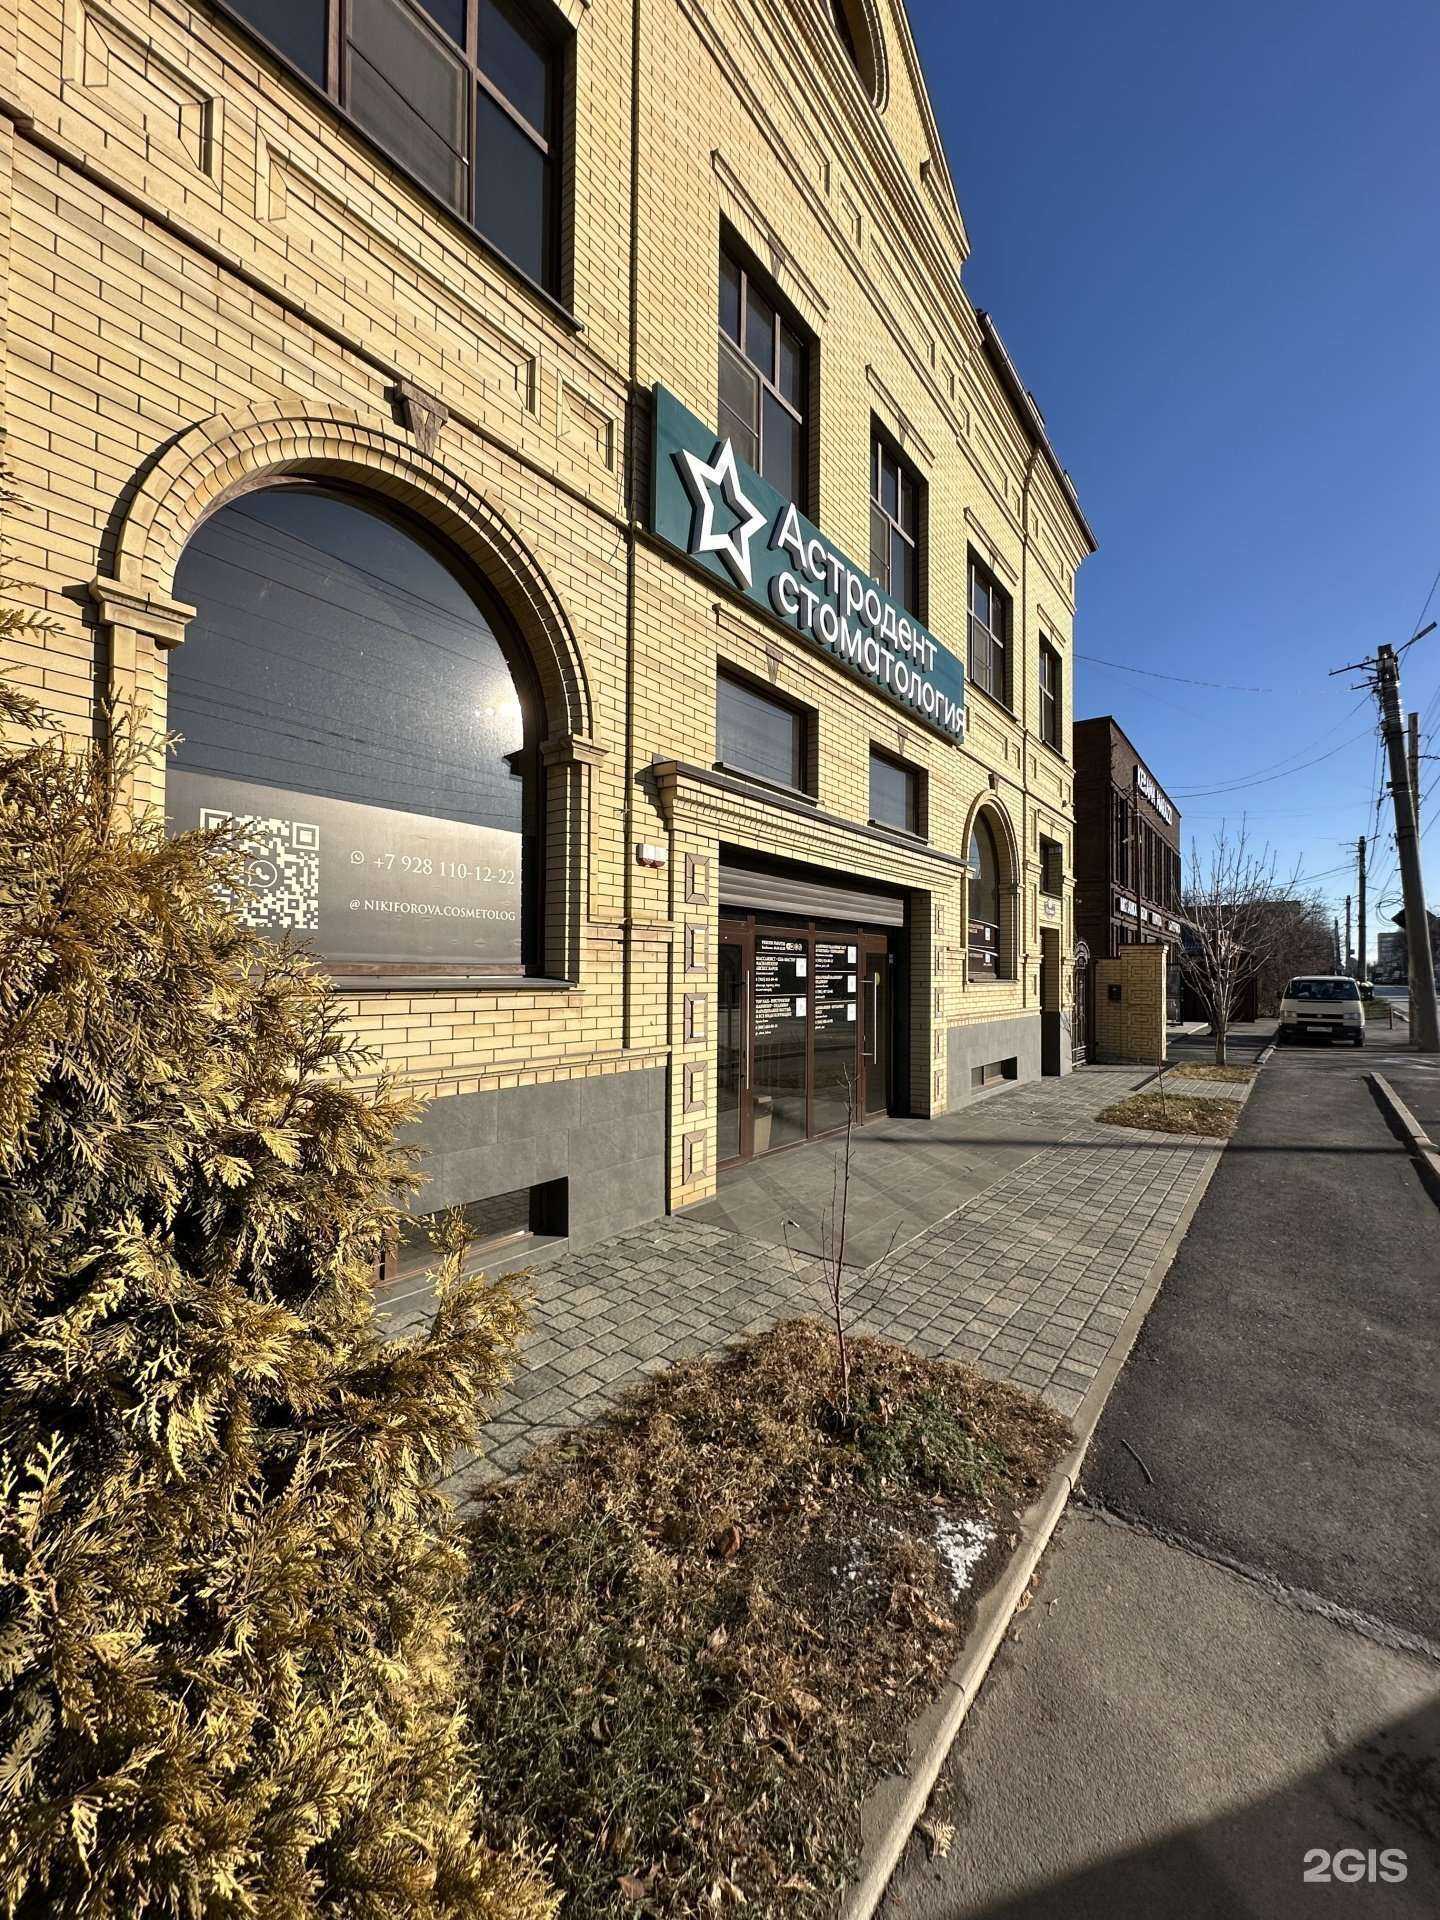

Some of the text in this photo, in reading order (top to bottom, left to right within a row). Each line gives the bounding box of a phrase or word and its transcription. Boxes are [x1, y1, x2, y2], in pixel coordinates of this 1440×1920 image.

[775, 501, 938, 671] Астродент
[774, 571, 966, 734] стоматология
[364, 899, 516, 921] NIKIFOROVA.COSMETOLOG
[373, 853, 515, 885] +7 928 110-12-22
